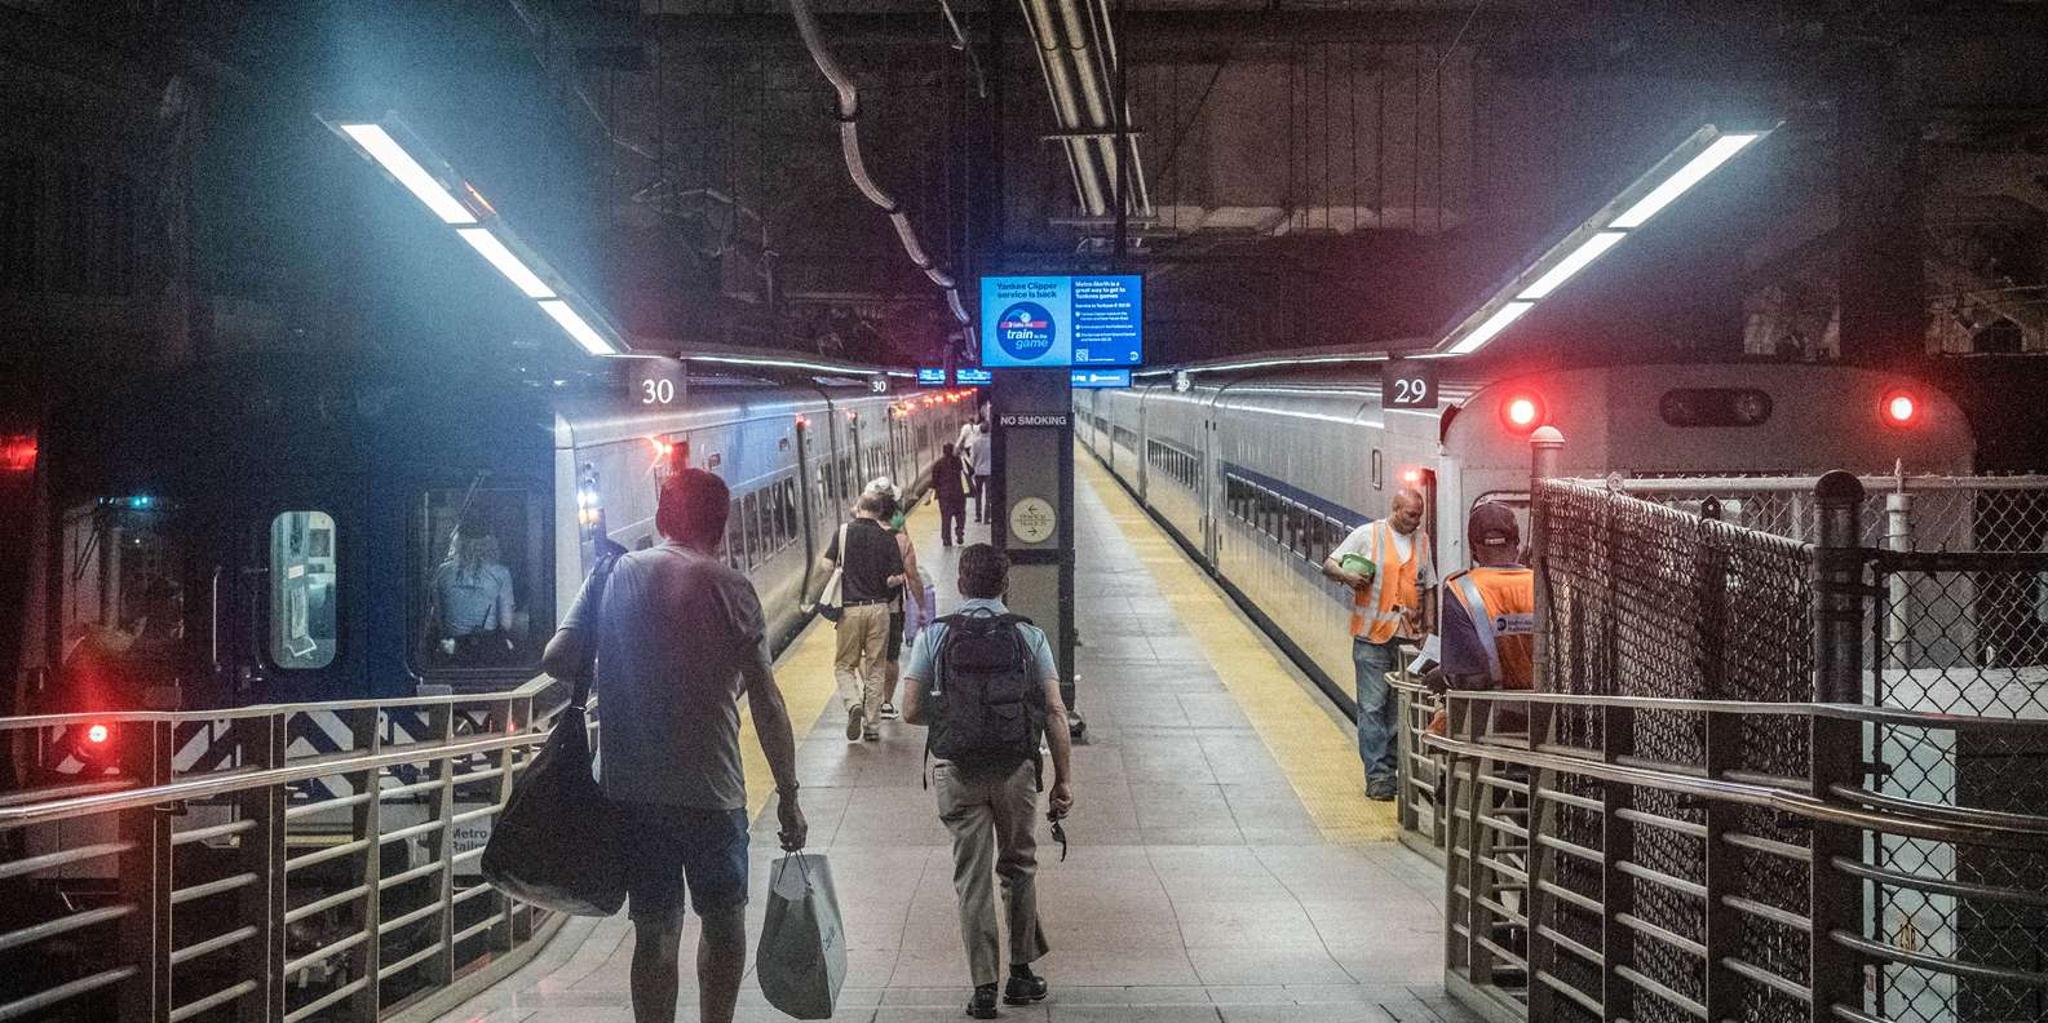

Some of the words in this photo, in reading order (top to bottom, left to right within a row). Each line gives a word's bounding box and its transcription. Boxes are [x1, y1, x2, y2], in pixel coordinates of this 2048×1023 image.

[997, 282, 1027, 290] Yankee
[1028, 282, 1057, 291] Clipper
[1037, 290, 1057, 298] back
[1007, 329, 1033, 339] train
[1016, 340, 1048, 350] game
[872, 380, 886, 392] 30
[642, 379, 674, 404] 30
[1394, 379, 1426, 404] 29
[1000, 415, 1016, 426] NO
[1017, 415, 1067, 426] SMOKING
